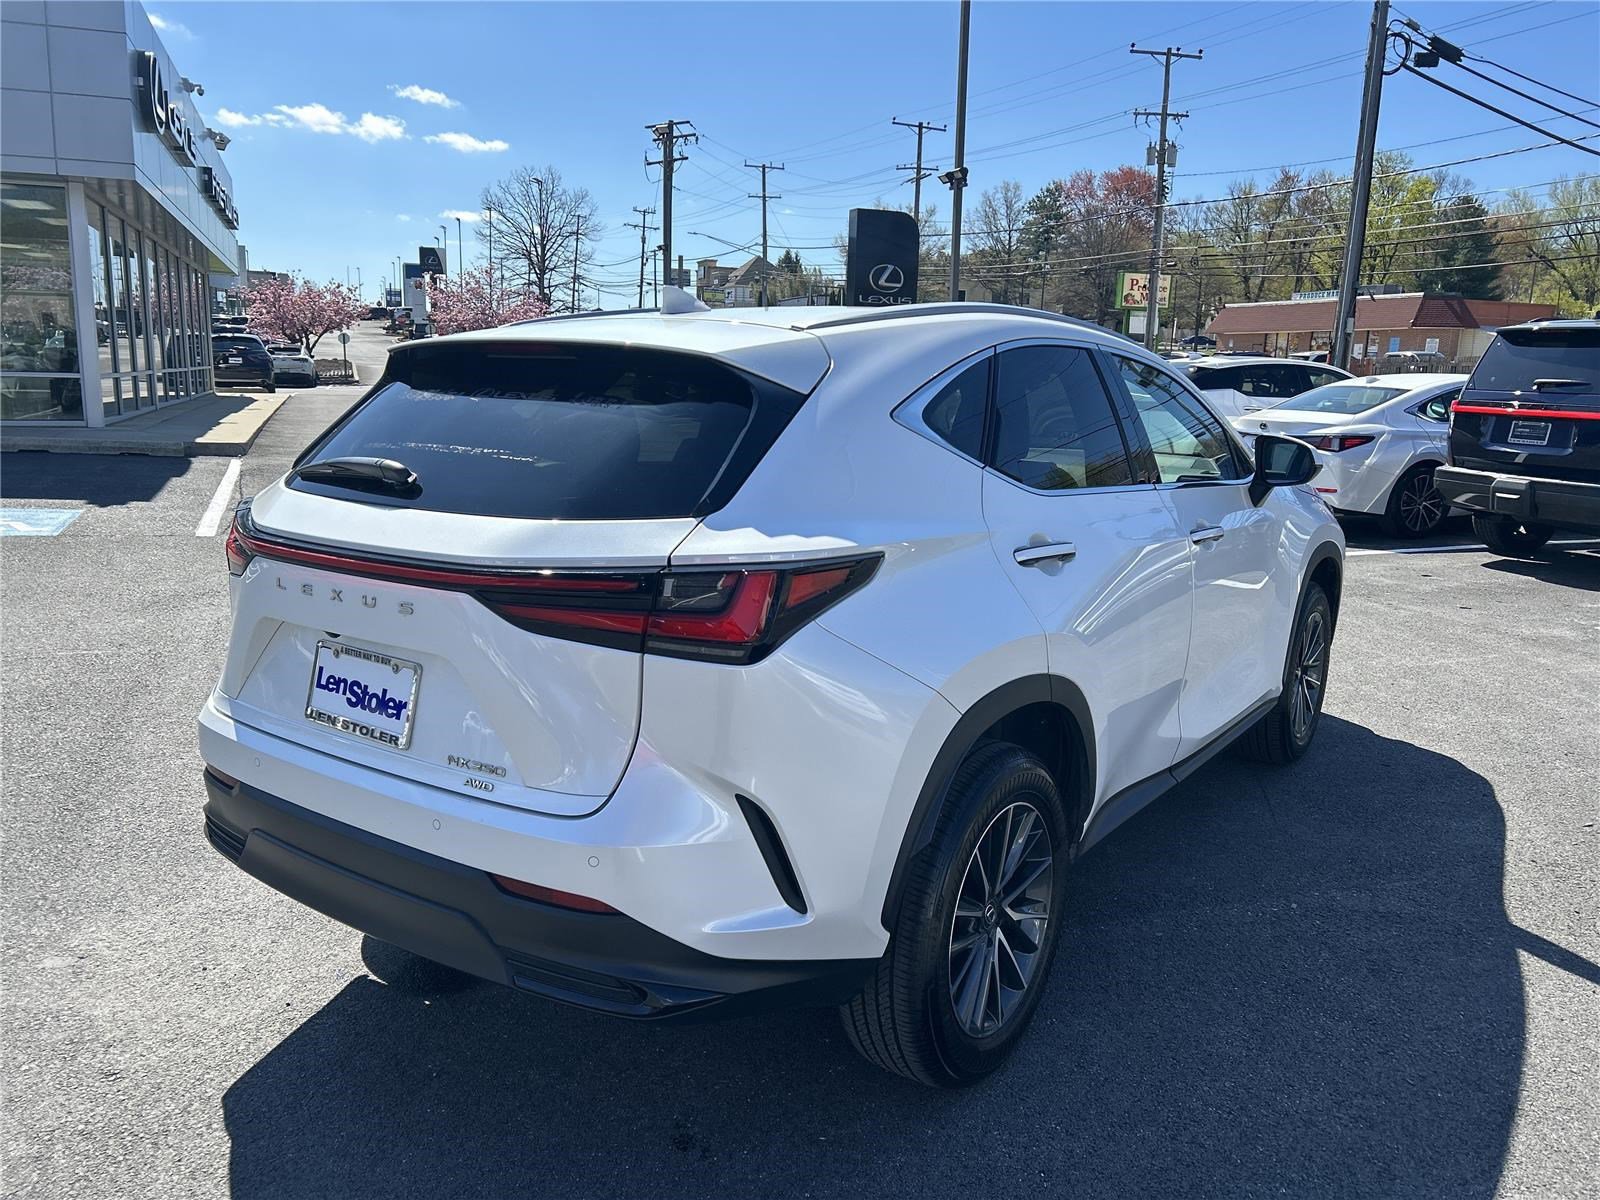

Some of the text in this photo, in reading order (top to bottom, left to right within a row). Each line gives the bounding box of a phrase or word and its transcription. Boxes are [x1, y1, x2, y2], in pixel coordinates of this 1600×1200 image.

[1129, 278, 1167, 293] Proce
[859, 294, 913, 304] LEXUS
[276, 577, 414, 615] LEXUS
[345, 647, 362, 659] BETTER
[363, 651, 373, 661] WAY
[373, 654, 381, 663] TO
[381, 656, 392, 666] BUY
[309, 709, 400, 746] LEN STOLER
[463, 777, 495, 792] AWD
